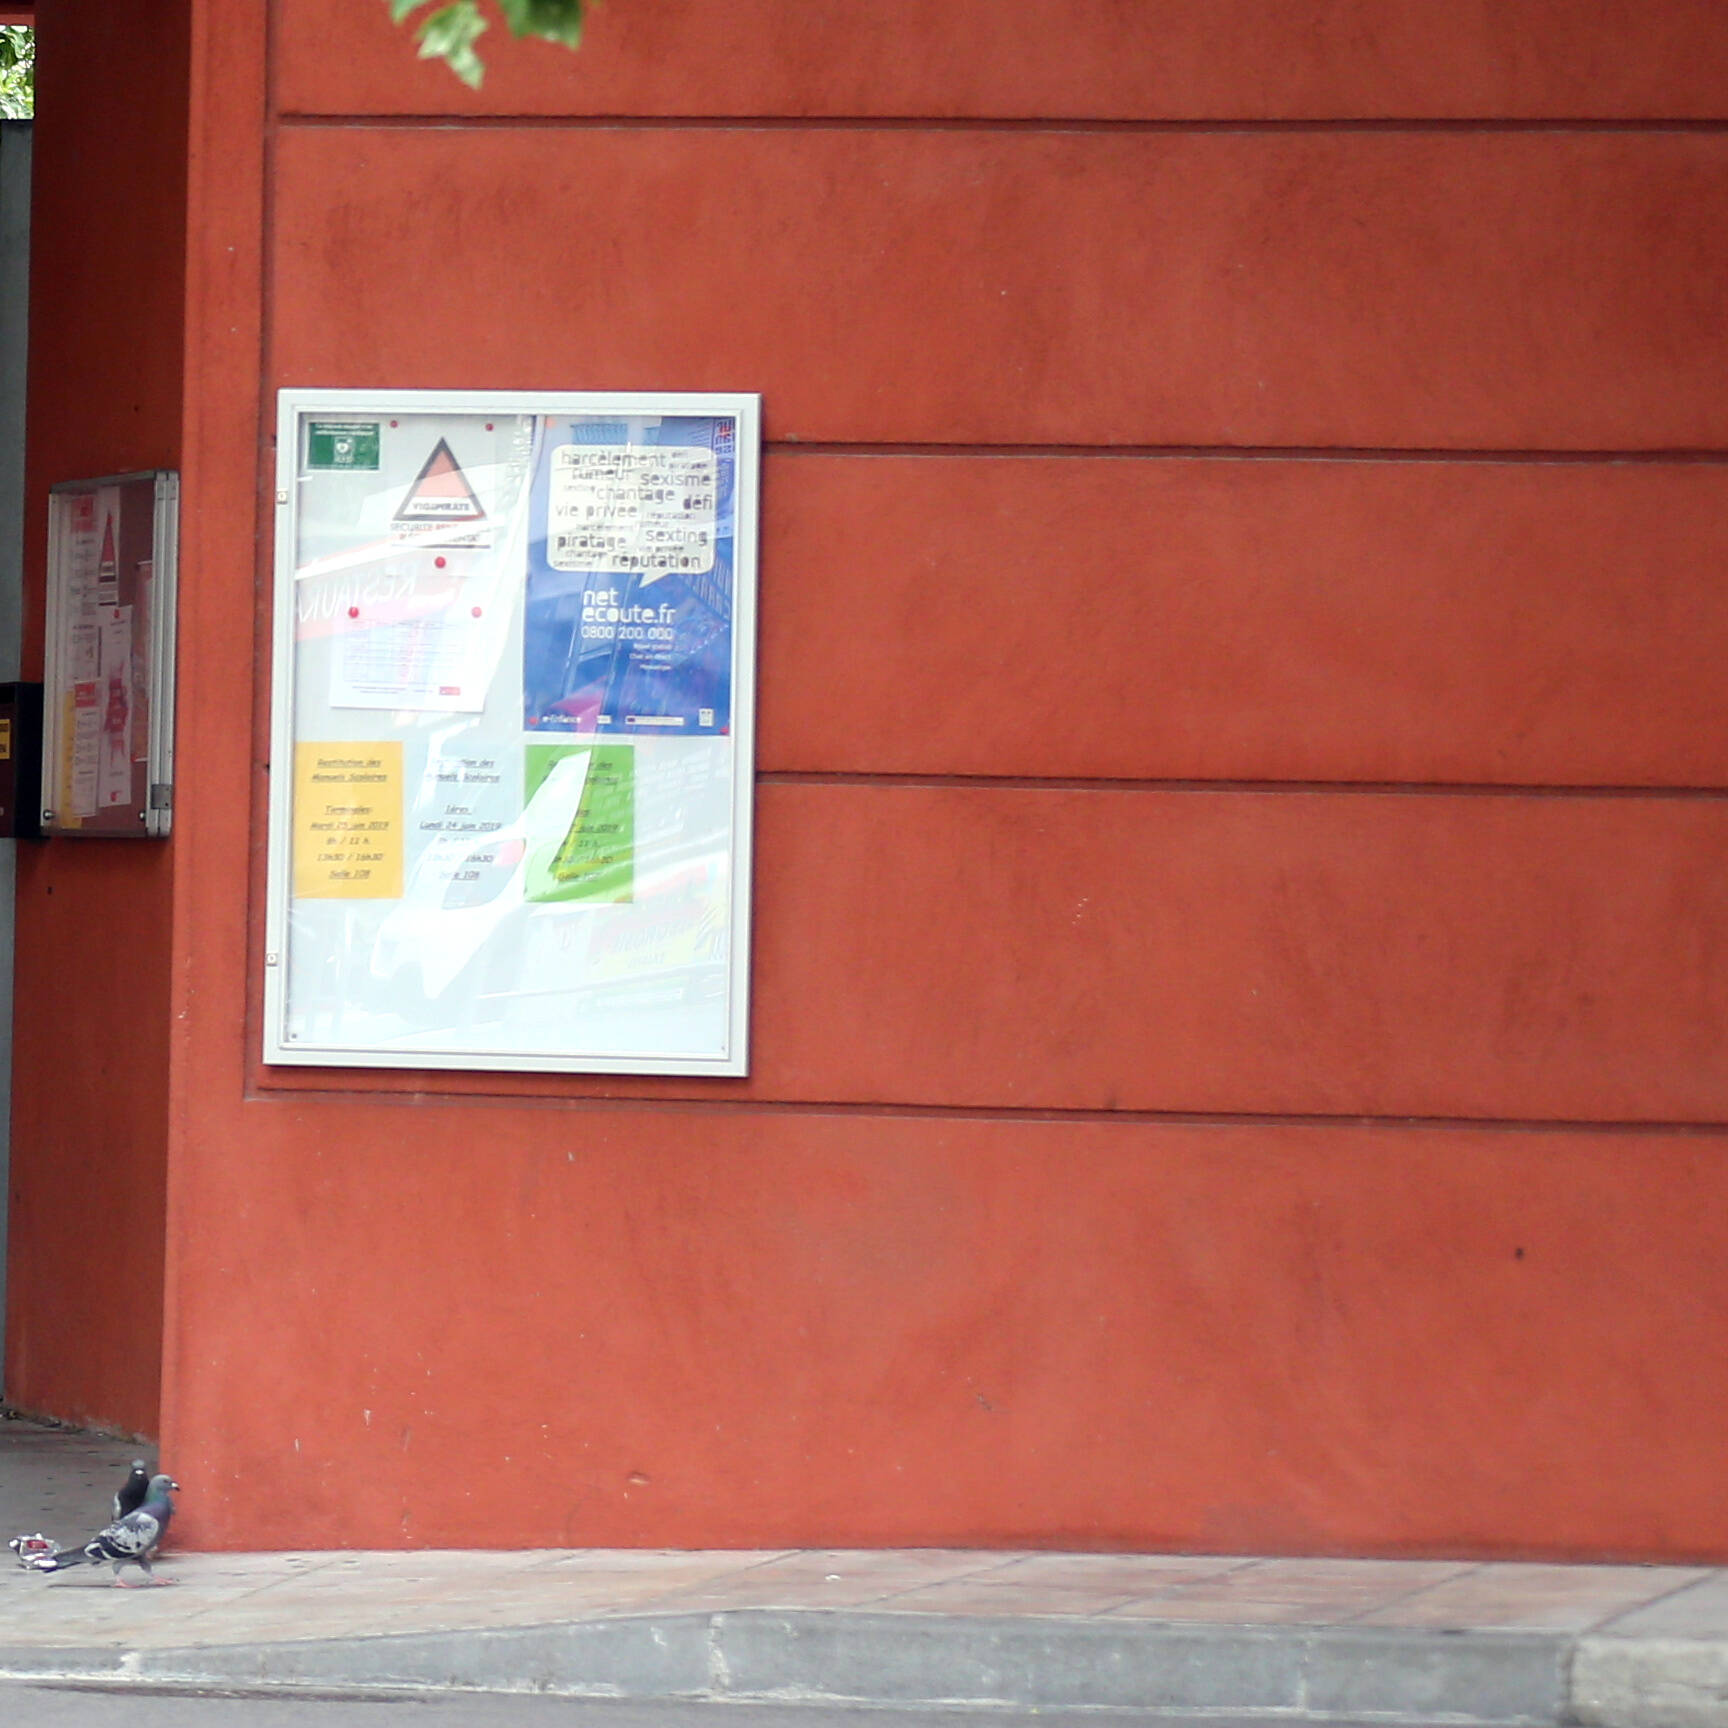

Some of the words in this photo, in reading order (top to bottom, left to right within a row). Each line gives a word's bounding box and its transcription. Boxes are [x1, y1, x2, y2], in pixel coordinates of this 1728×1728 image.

[640, 471, 712, 487] sexisme
[595, 486, 676, 505] chantage
[682, 494, 713, 511] défi
[555, 504, 579, 517] vie
[585, 504, 638, 520] privée
[556, 533, 627, 551] piratage
[645, 528, 709, 547] sexting
[611, 551, 701, 570] réputation
[583, 587, 619, 606] net
[582, 603, 676, 624] ecoute.fr
[581, 625, 615, 639] 0800
[618, 627, 644, 640] 200
[647, 627, 674, 640] 000
